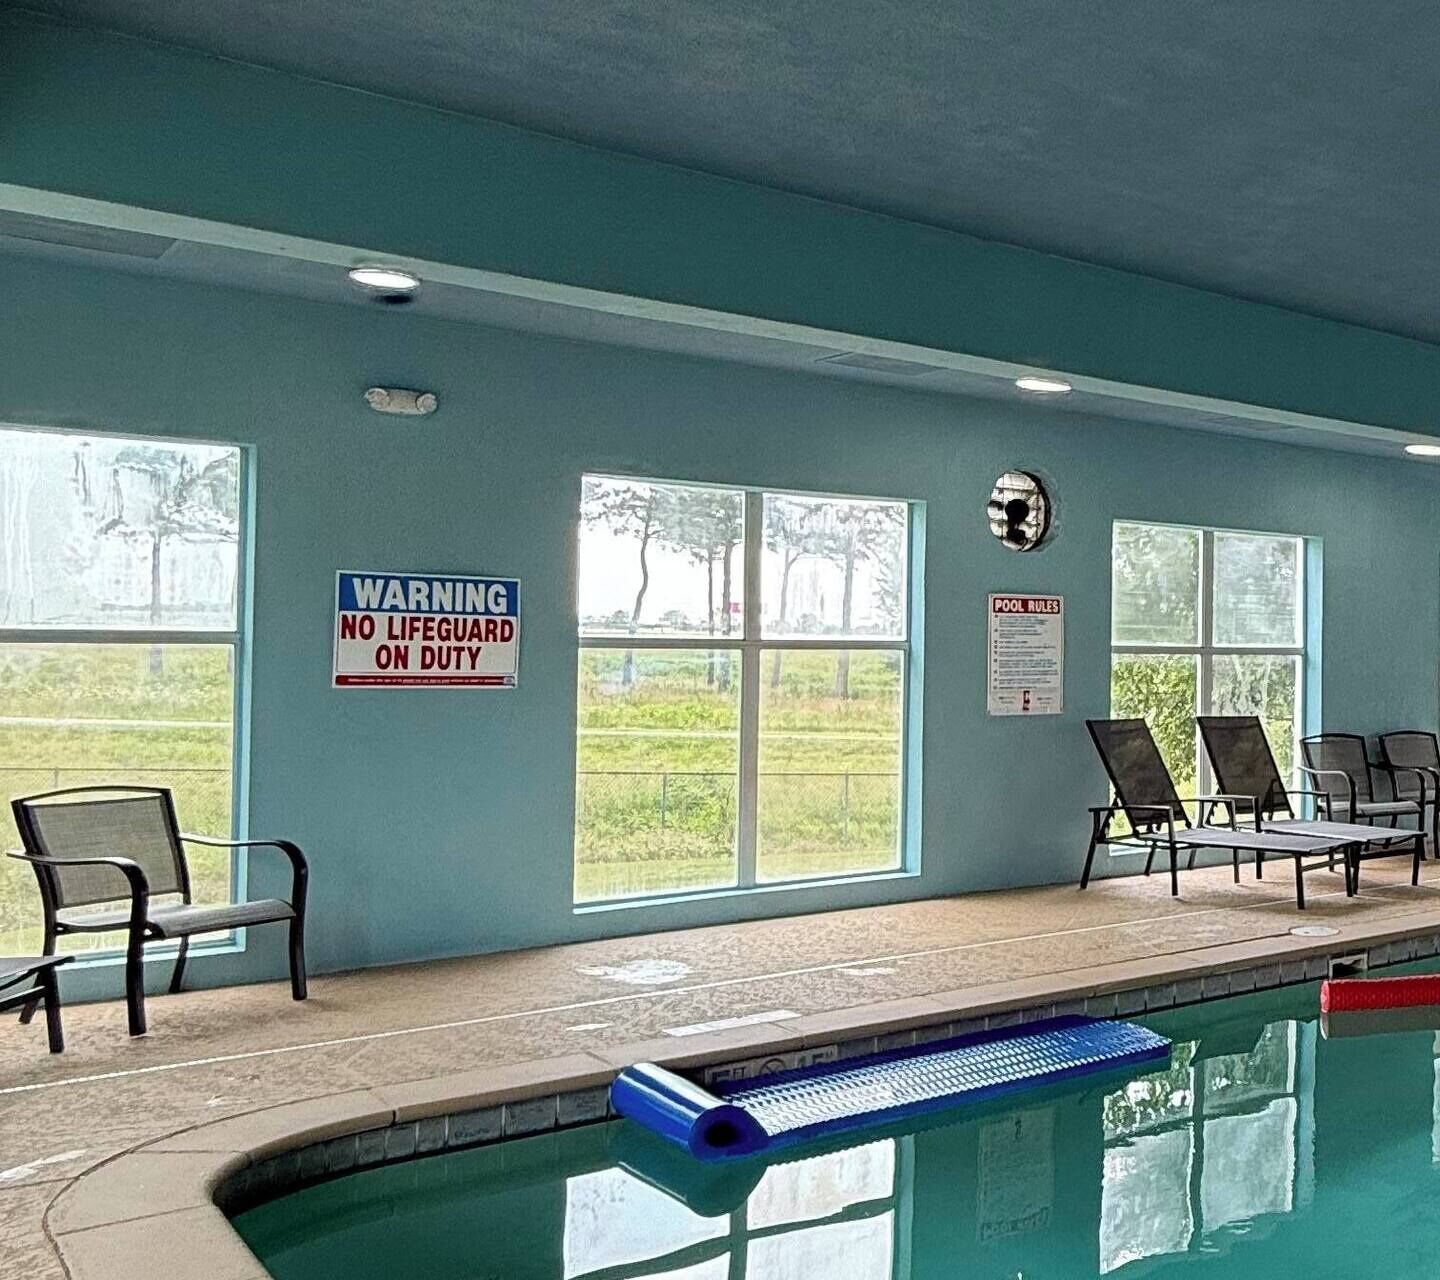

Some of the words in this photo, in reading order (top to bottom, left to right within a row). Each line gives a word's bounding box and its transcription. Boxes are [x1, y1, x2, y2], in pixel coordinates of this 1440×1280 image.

[352, 577, 508, 614] WARNING
[994, 599, 1025, 612] POOL
[1028, 600, 1059, 613] RULES
[341, 614, 376, 641] NO
[387, 615, 514, 643] LIFEGUARD
[375, 644, 409, 671] ON
[420, 645, 482, 671] DUTY
